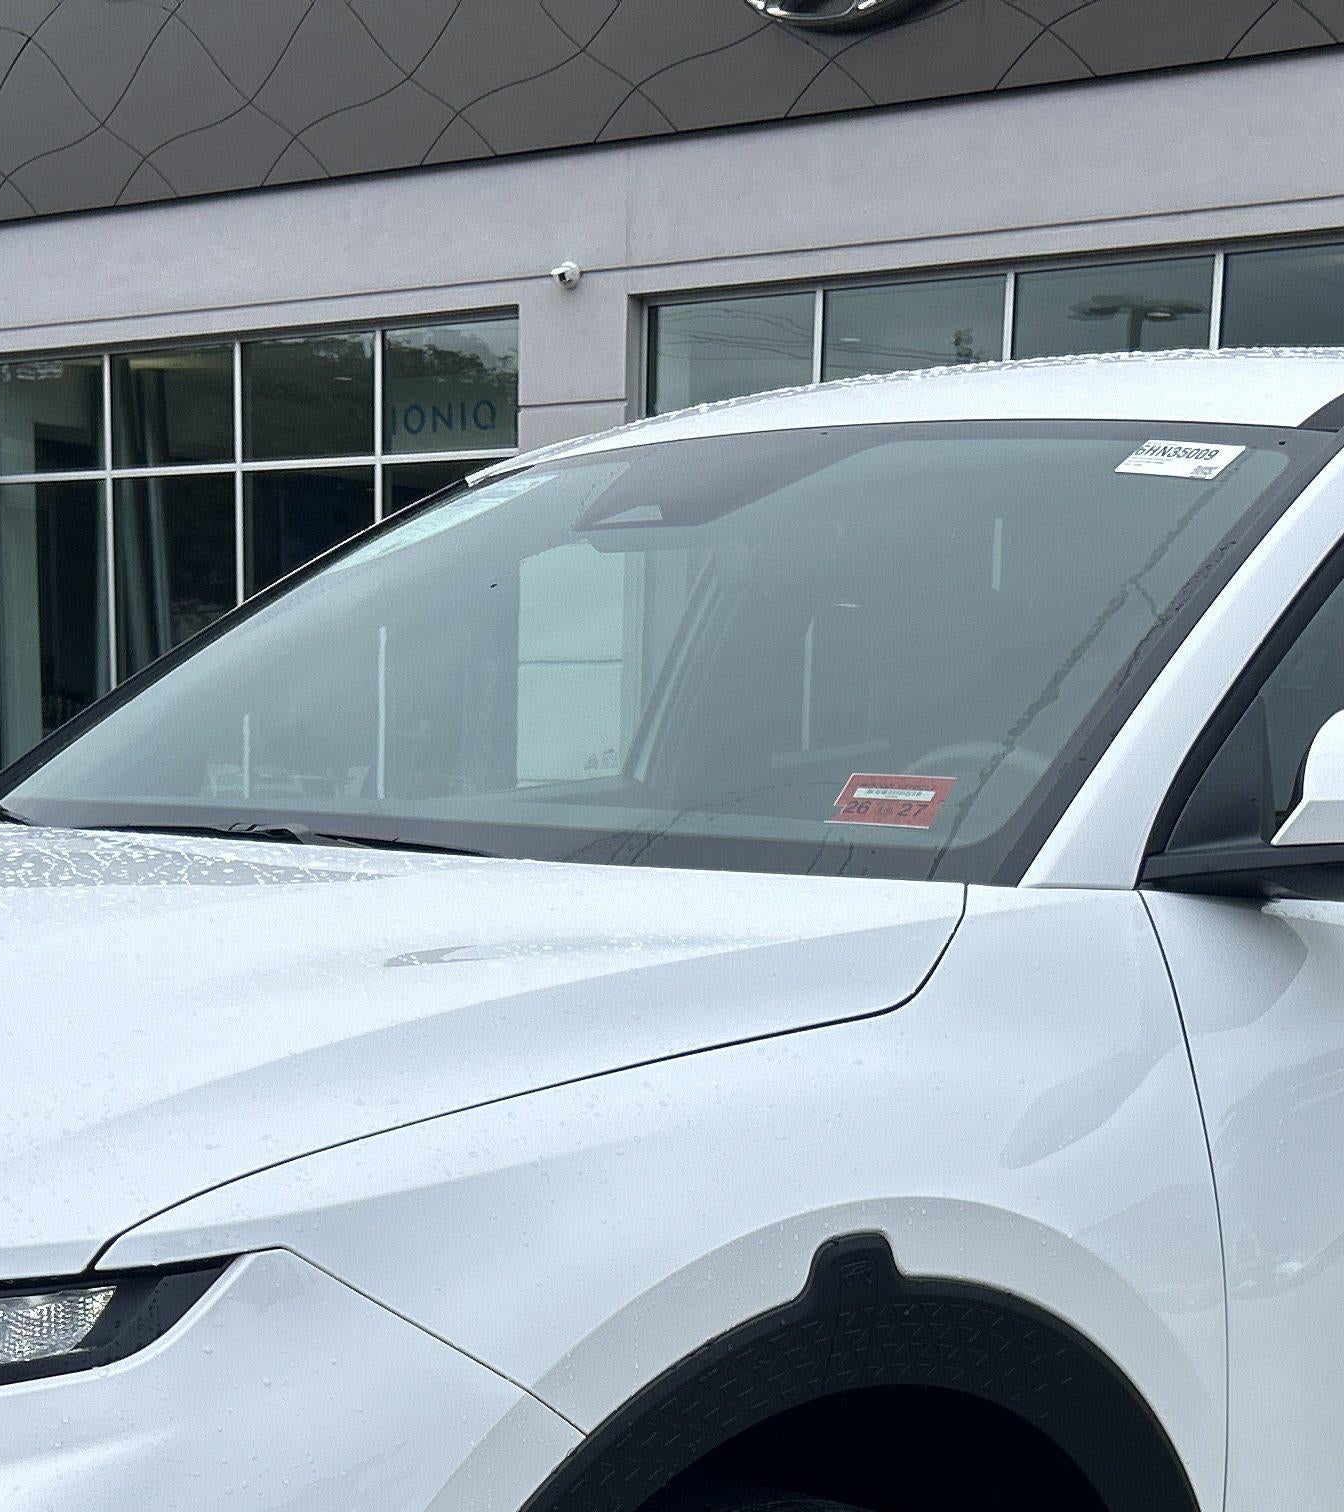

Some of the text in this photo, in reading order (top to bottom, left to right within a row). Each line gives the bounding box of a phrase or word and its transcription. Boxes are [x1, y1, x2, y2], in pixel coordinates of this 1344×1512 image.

[390, 398, 497, 436] IONIQ
[842, 800, 871, 815] 26
[896, 802, 929, 817] 27
